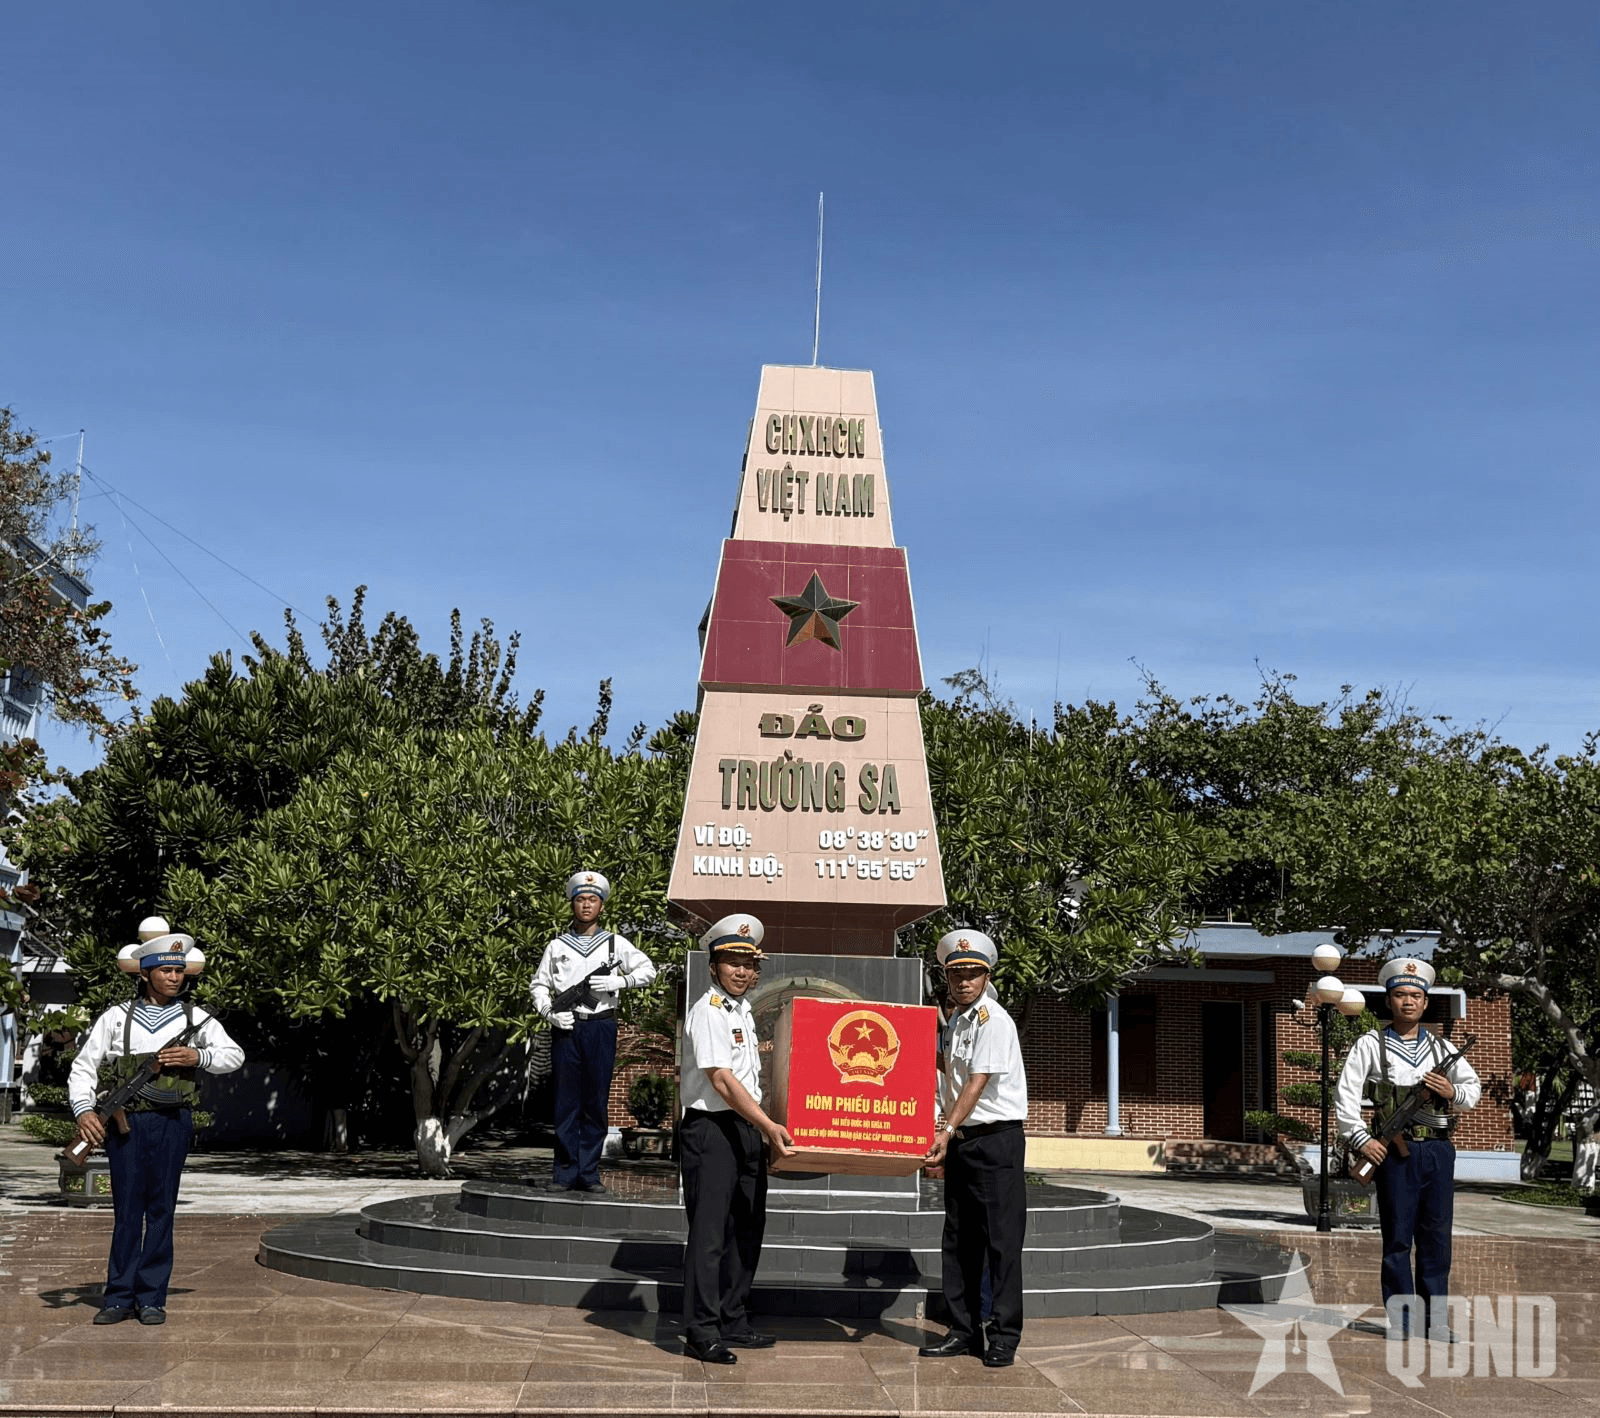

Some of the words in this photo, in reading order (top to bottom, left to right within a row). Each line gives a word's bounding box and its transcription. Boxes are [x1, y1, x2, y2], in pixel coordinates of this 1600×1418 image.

[766, 413, 865, 459] CHXHCN
[757, 461, 809, 522] VIỆT
[816, 472, 875, 518] NAM
[758, 703, 867, 741] ĐẢO
[718, 749, 846, 813] TRƯỜNG
[858, 762, 901, 815] SA
[694, 821, 715, 846] VĨ
[718, 823, 752, 851] ĐỘ:
[692, 855, 744, 877] KINH
[748, 853, 783, 882] ĐỘ:
[805, 1092, 833, 1111] HÒM
[835, 1093, 870, 1114] PHIẾU
[900, 1097, 917, 1117] CỬ
